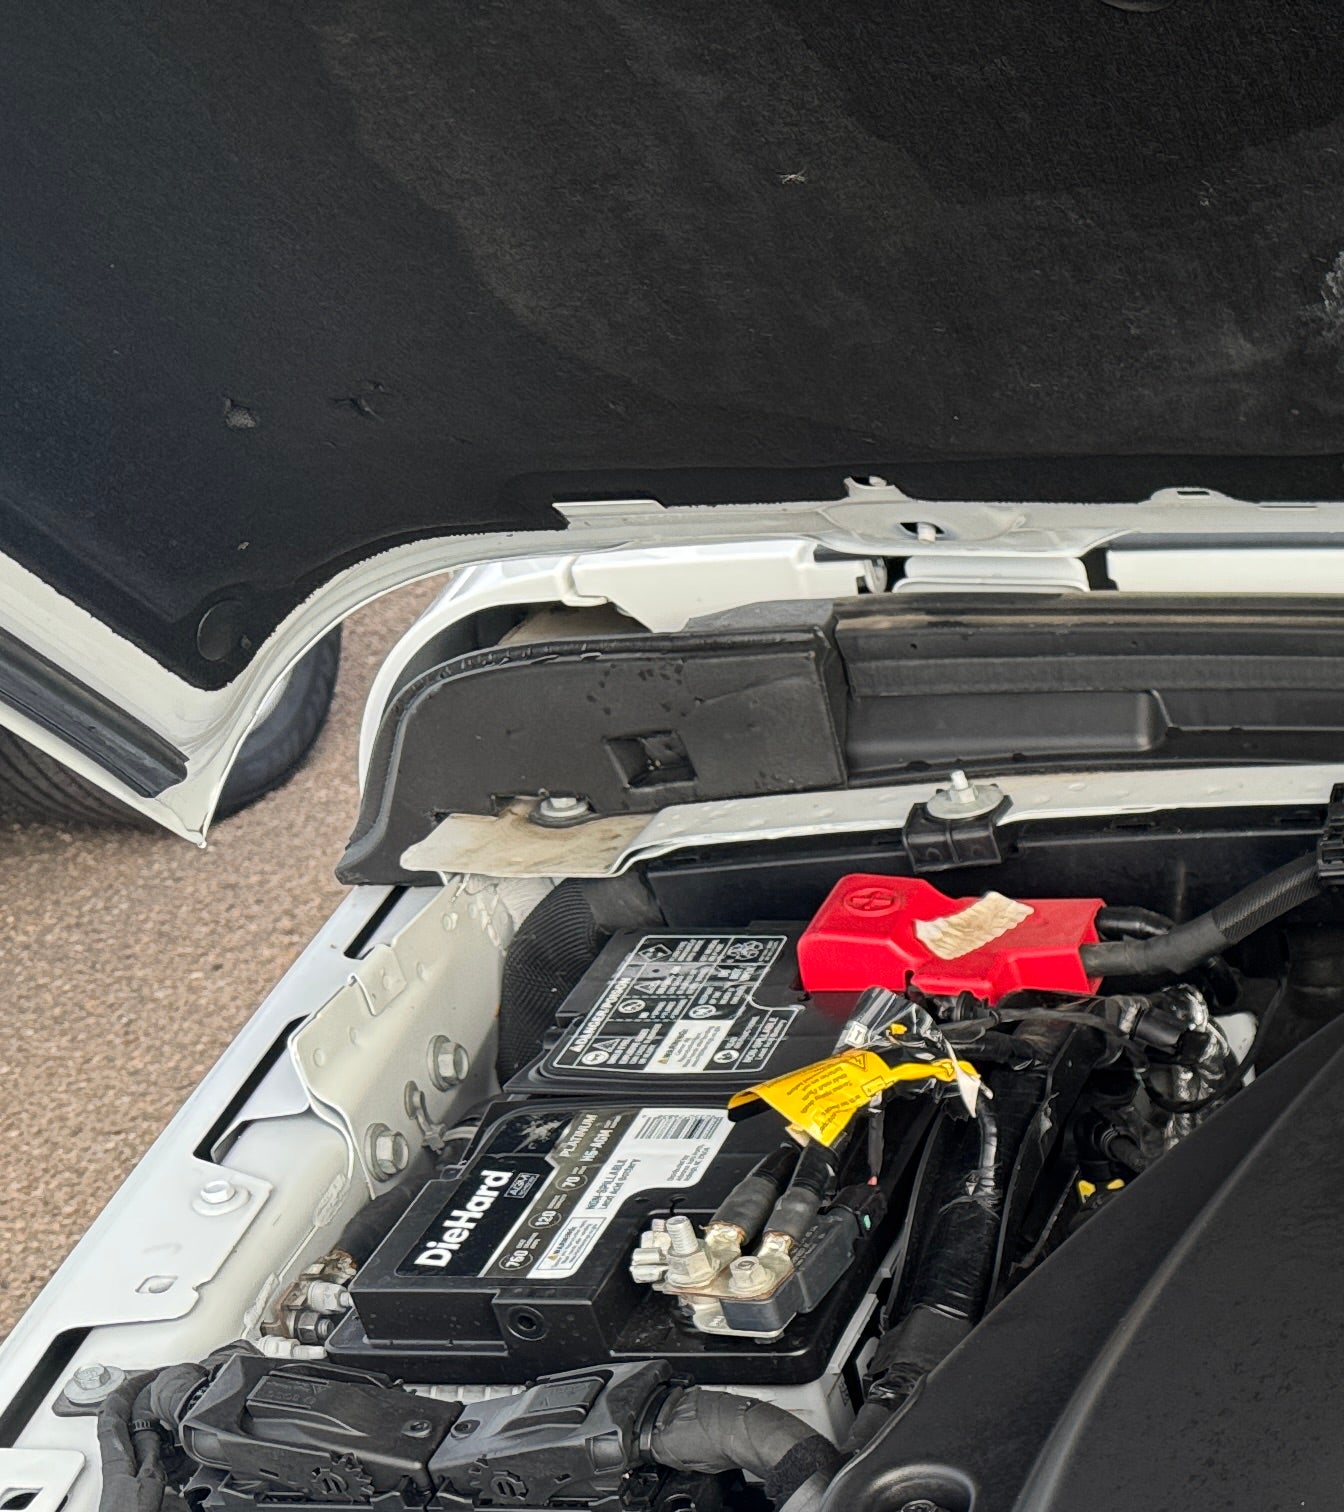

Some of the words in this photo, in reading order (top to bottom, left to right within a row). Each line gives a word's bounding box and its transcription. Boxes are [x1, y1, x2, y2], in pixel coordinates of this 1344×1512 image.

[559, 1114, 598, 1158] PLATINUM
[414, 1169, 513, 1268] DieHard
[505, 1249, 528, 1268] 760
[535, 1210, 556, 1227] 120
[561, 1174, 581, 1188] 70
